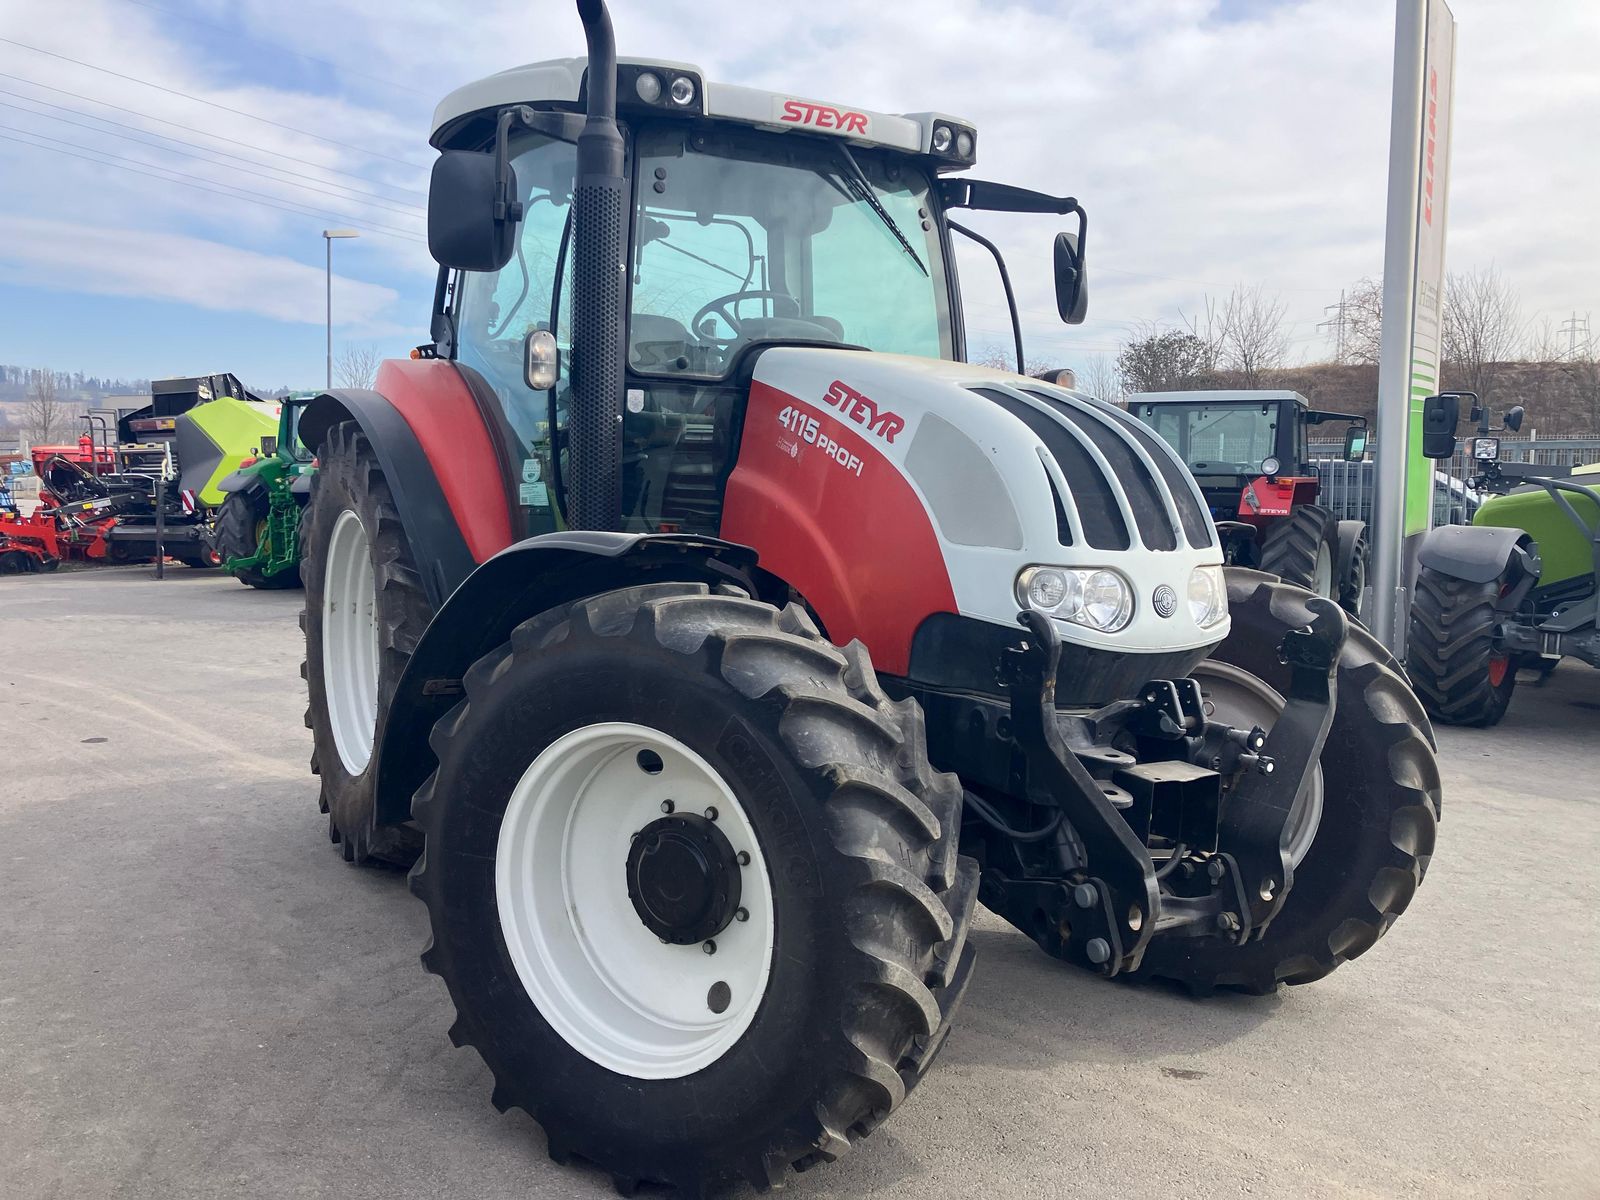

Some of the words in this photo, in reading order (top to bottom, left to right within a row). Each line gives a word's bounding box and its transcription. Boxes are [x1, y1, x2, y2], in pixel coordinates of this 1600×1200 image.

[781, 101, 868, 135] STEYR
[1424, 65, 1437, 226] CLAAS
[778, 405, 820, 444] 4115
[816, 433, 864, 477] PROFI
[823, 379, 905, 444] STEYR
